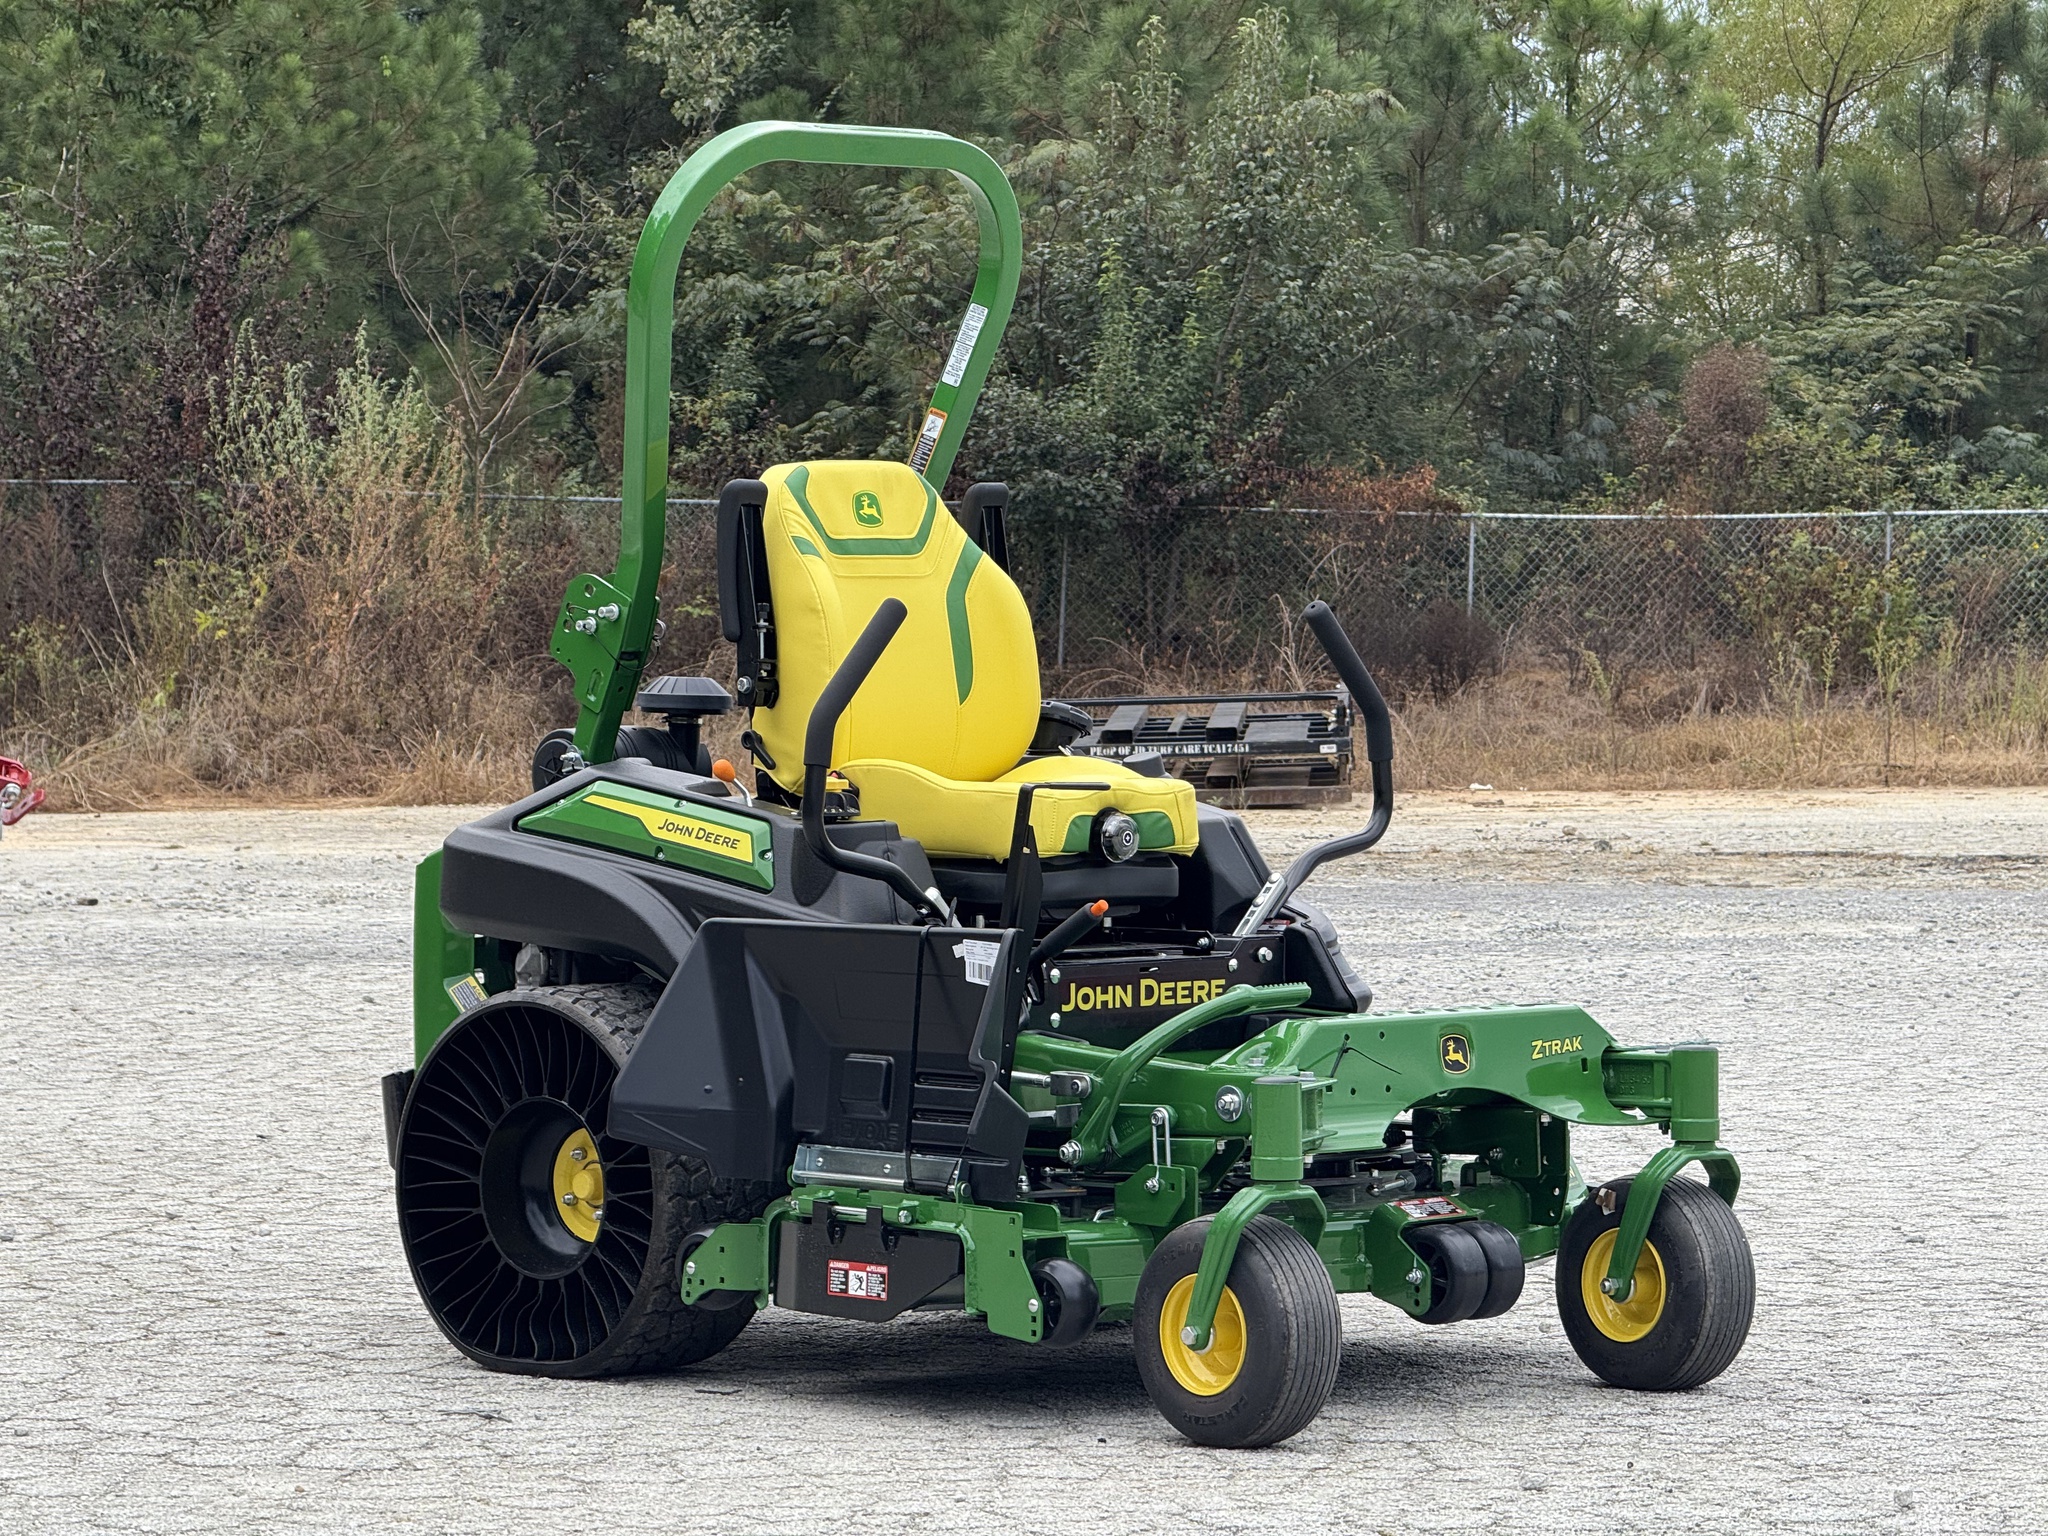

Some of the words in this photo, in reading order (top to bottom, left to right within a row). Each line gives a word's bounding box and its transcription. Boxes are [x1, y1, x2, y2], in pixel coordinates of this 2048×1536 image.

[1118, 746, 1131, 755] OF
[1175, 744, 1201, 754] CARE
[657, 818, 694, 838] JOHN
[694, 827, 740, 850] DEERE
[1061, 982, 1132, 1012] JOHN
[1139, 978, 1226, 1007] DEERE
[1531, 1035, 1583, 1060] ZTRAK
